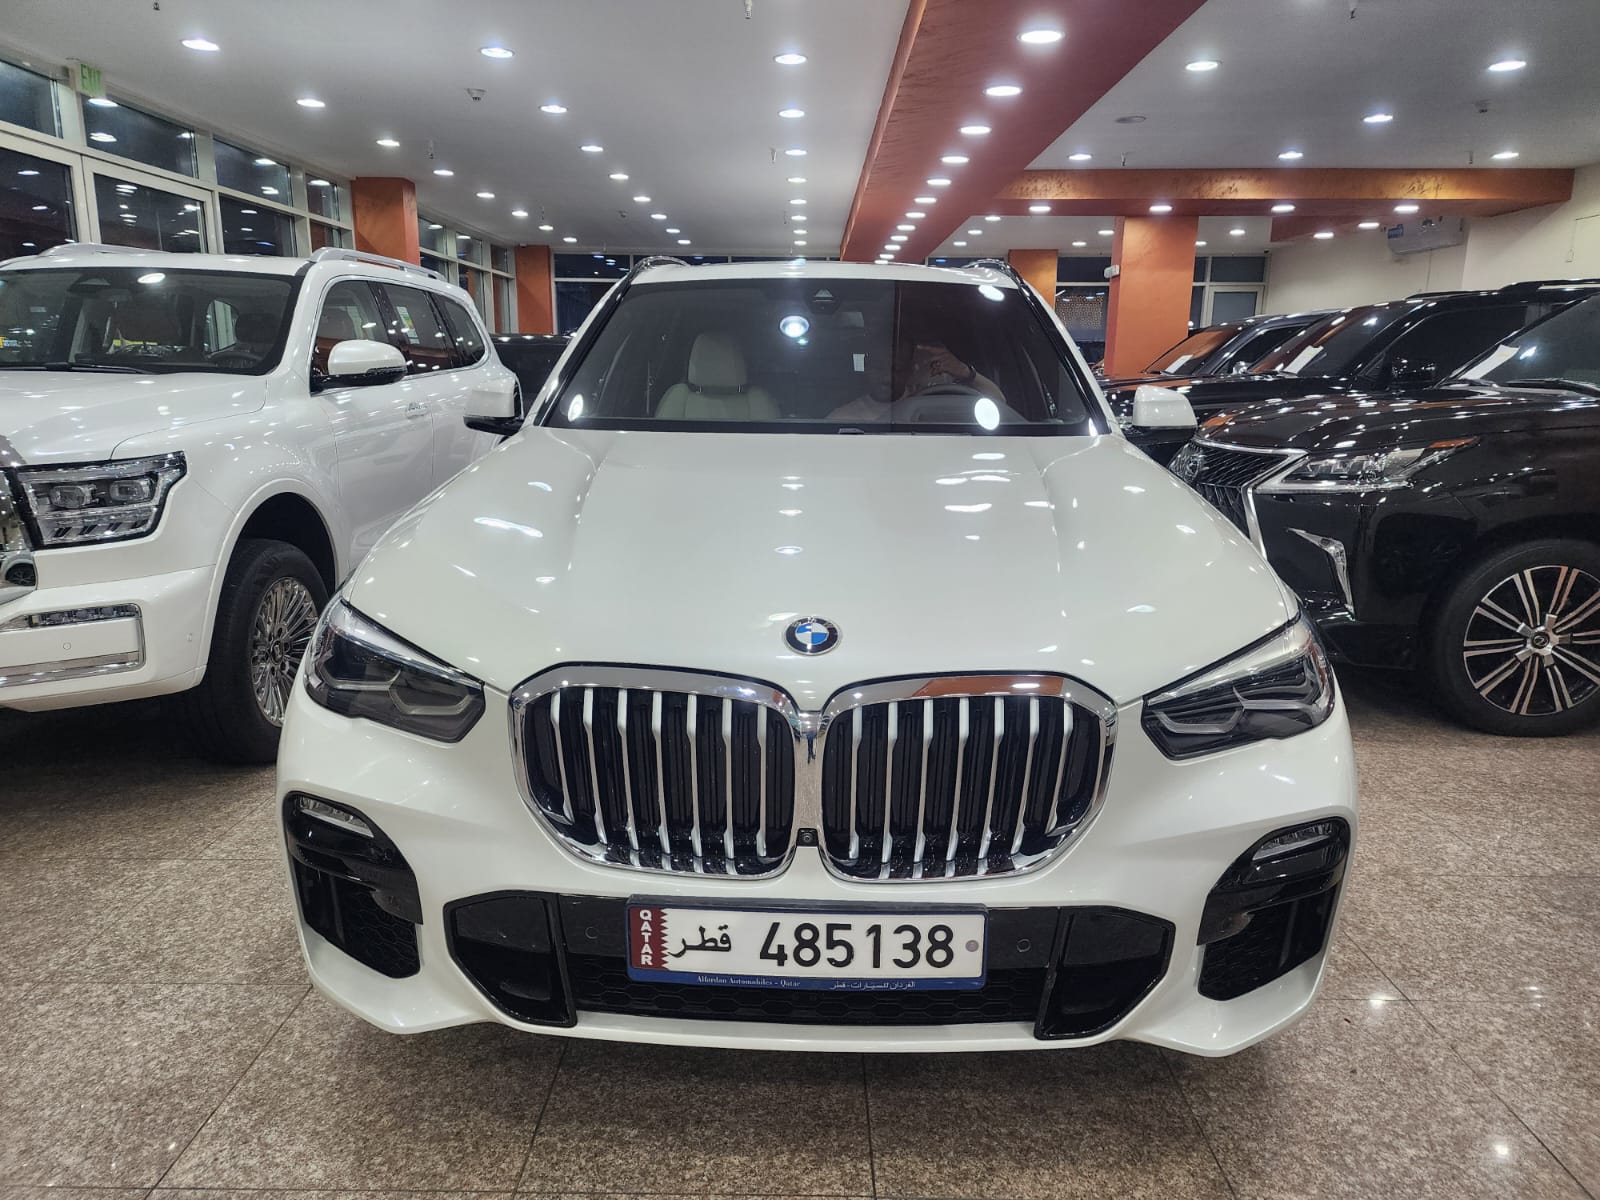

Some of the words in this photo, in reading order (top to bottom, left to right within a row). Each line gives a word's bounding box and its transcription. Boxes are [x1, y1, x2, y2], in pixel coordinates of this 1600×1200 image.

[639, 909, 653, 966] QATAR
[667, 924, 732, 958] قطر
[759, 921, 954, 969] 485138
[780, 979, 801, 988] Qatar
